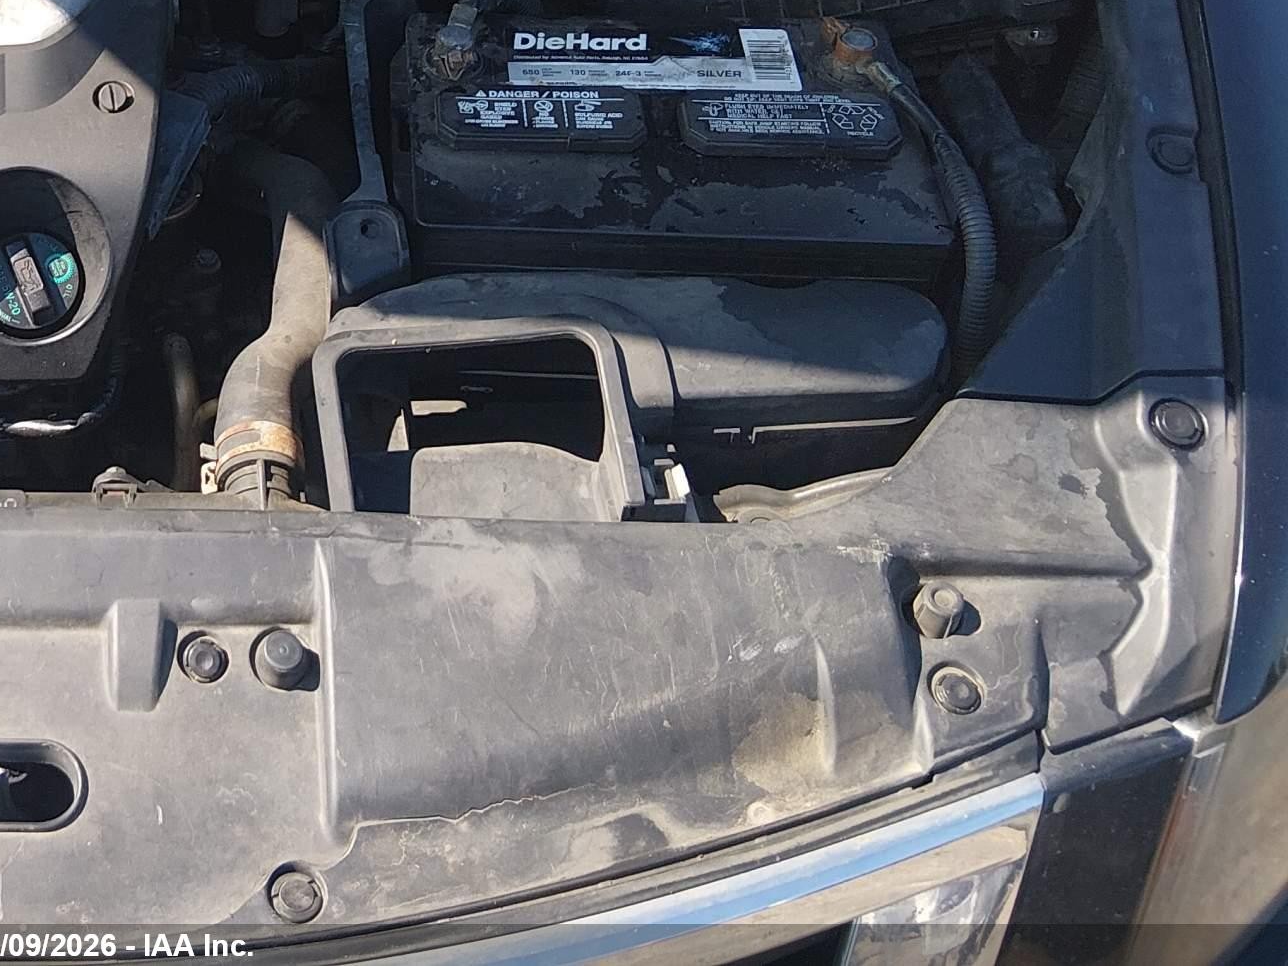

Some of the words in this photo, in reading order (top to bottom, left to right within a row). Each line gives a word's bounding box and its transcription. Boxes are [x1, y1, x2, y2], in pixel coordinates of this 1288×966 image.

[513, 33, 648, 51] DieHard
[697, 69, 742, 78] SILVER
[489, 90, 540, 98] DANGER
[553, 90, 600, 99] POISON
